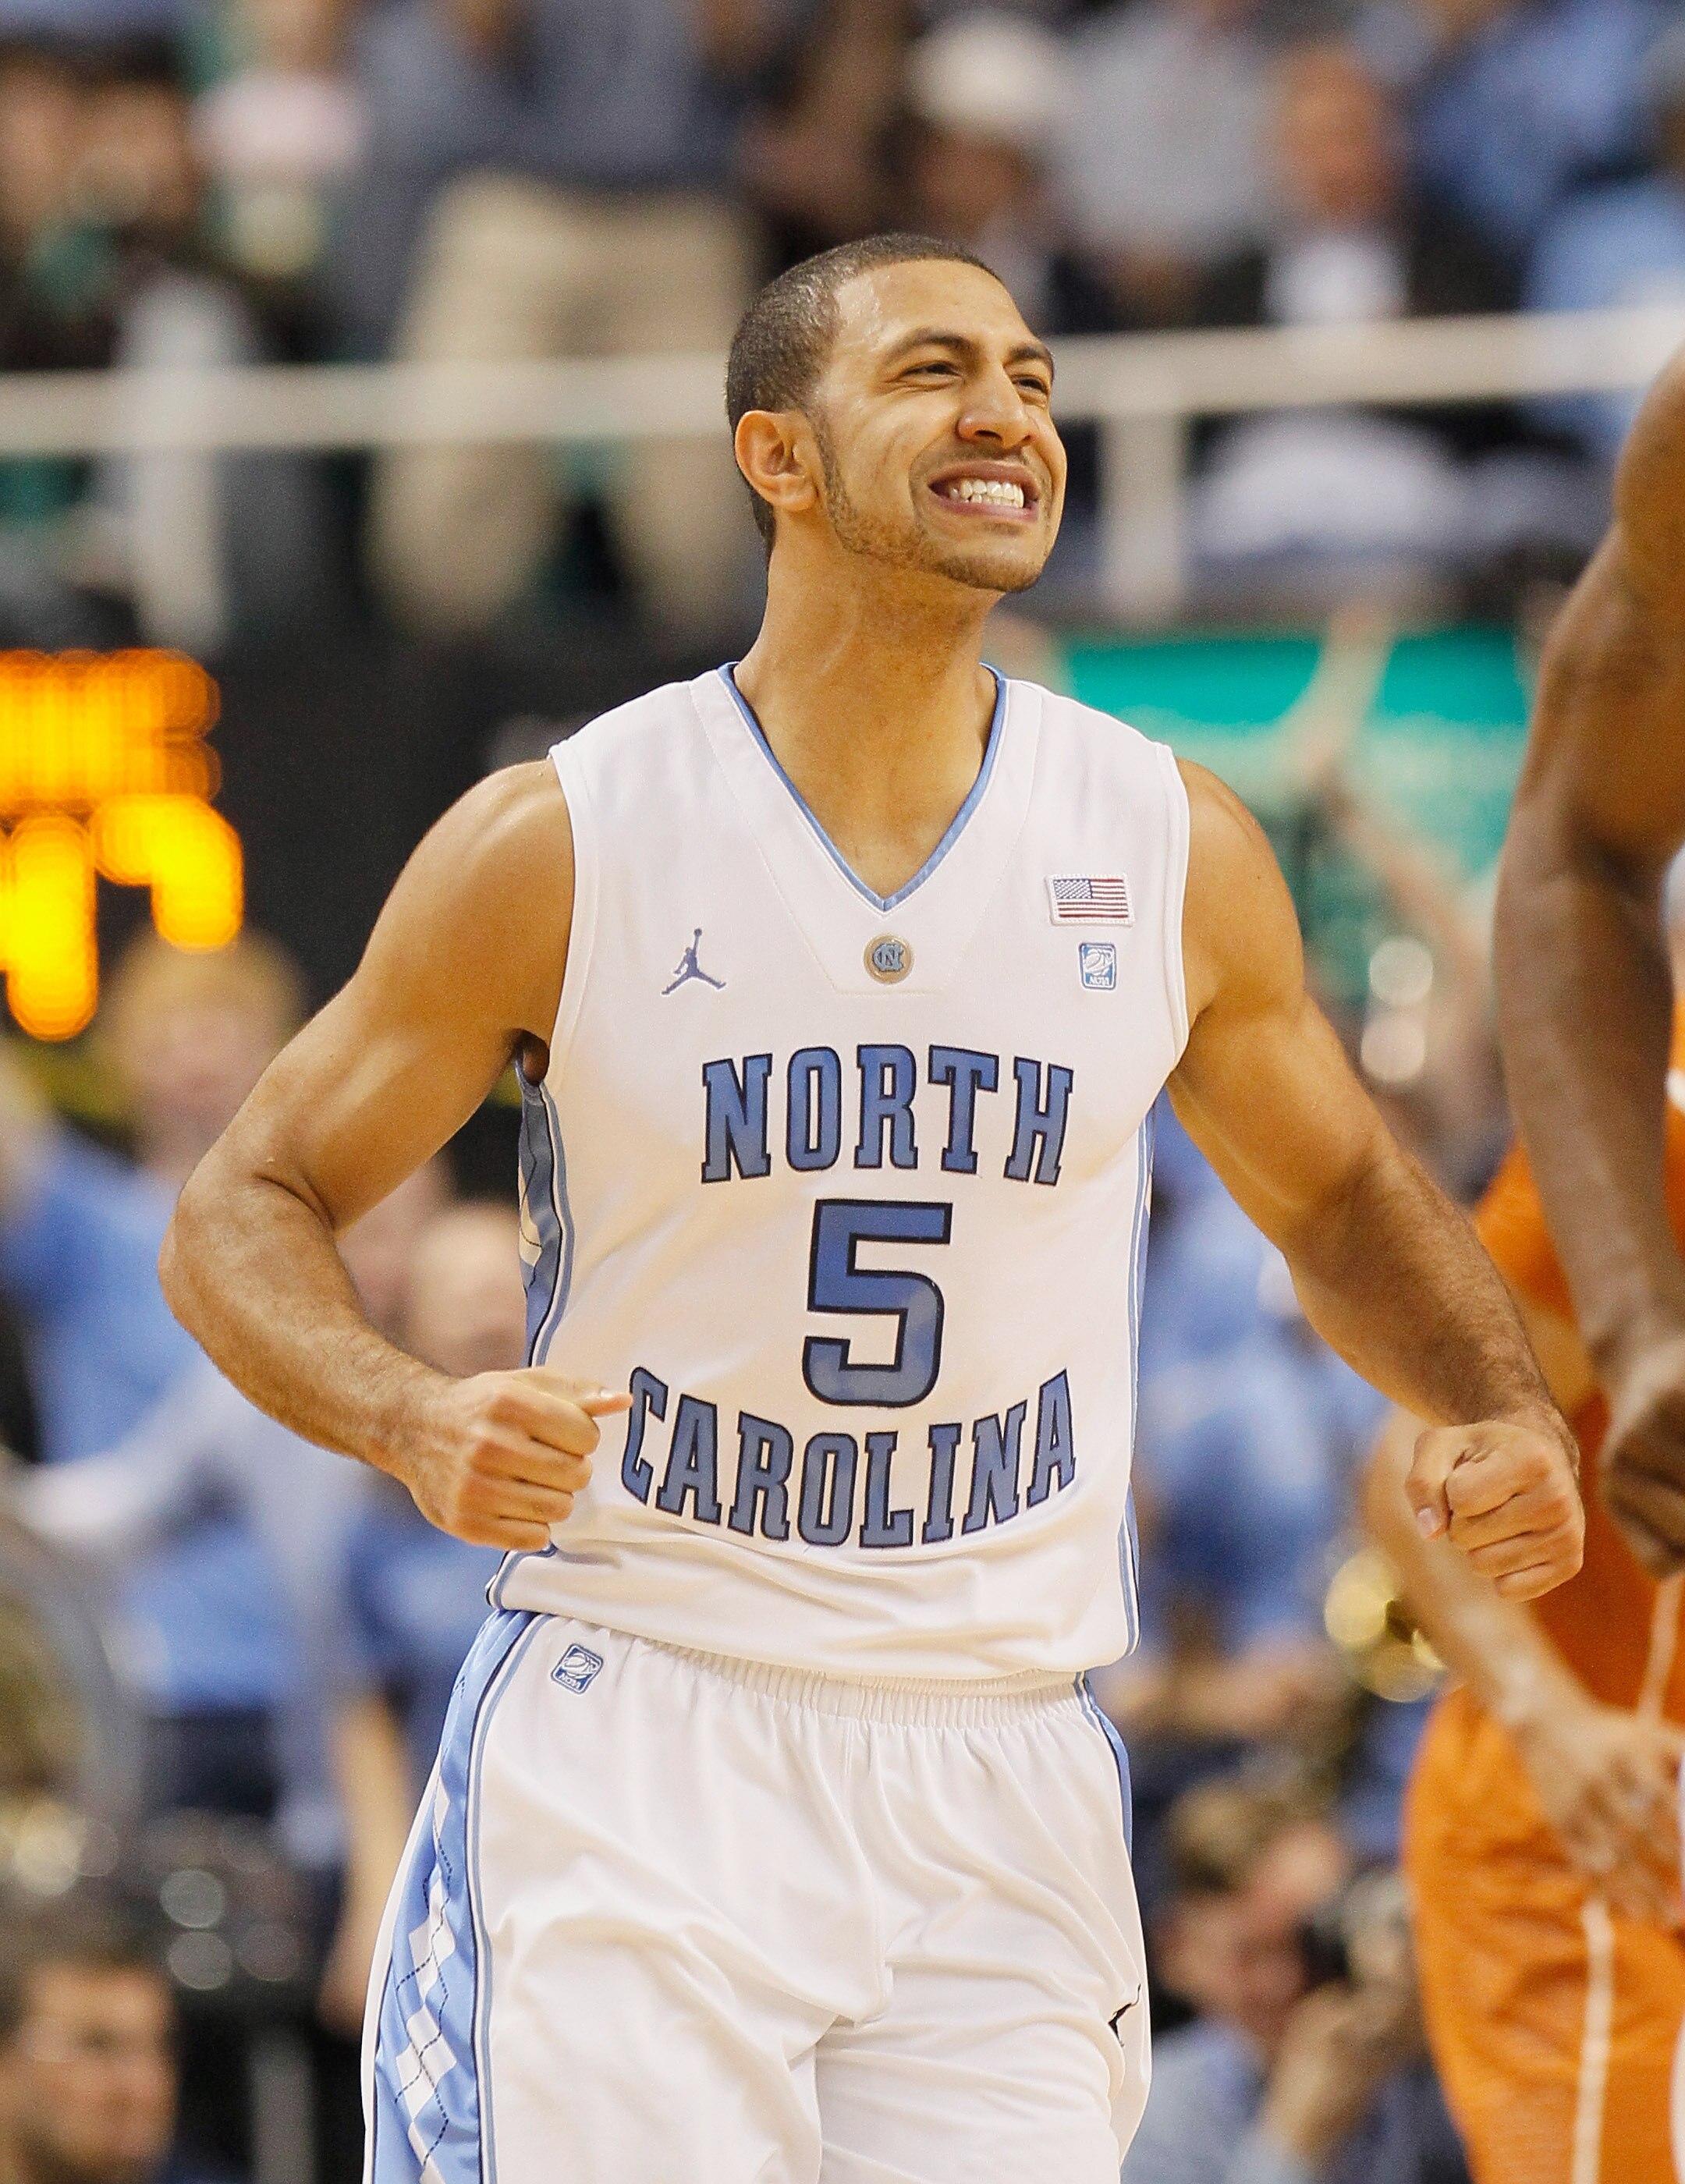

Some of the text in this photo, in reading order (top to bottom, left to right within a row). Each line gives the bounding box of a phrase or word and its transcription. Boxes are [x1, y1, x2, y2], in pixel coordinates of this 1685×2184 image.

[700, 1043, 1073, 1186] NORTH
[801, 1198, 952, 1408] 5
[620, 1366, 1077, 1548] CAROLINA
